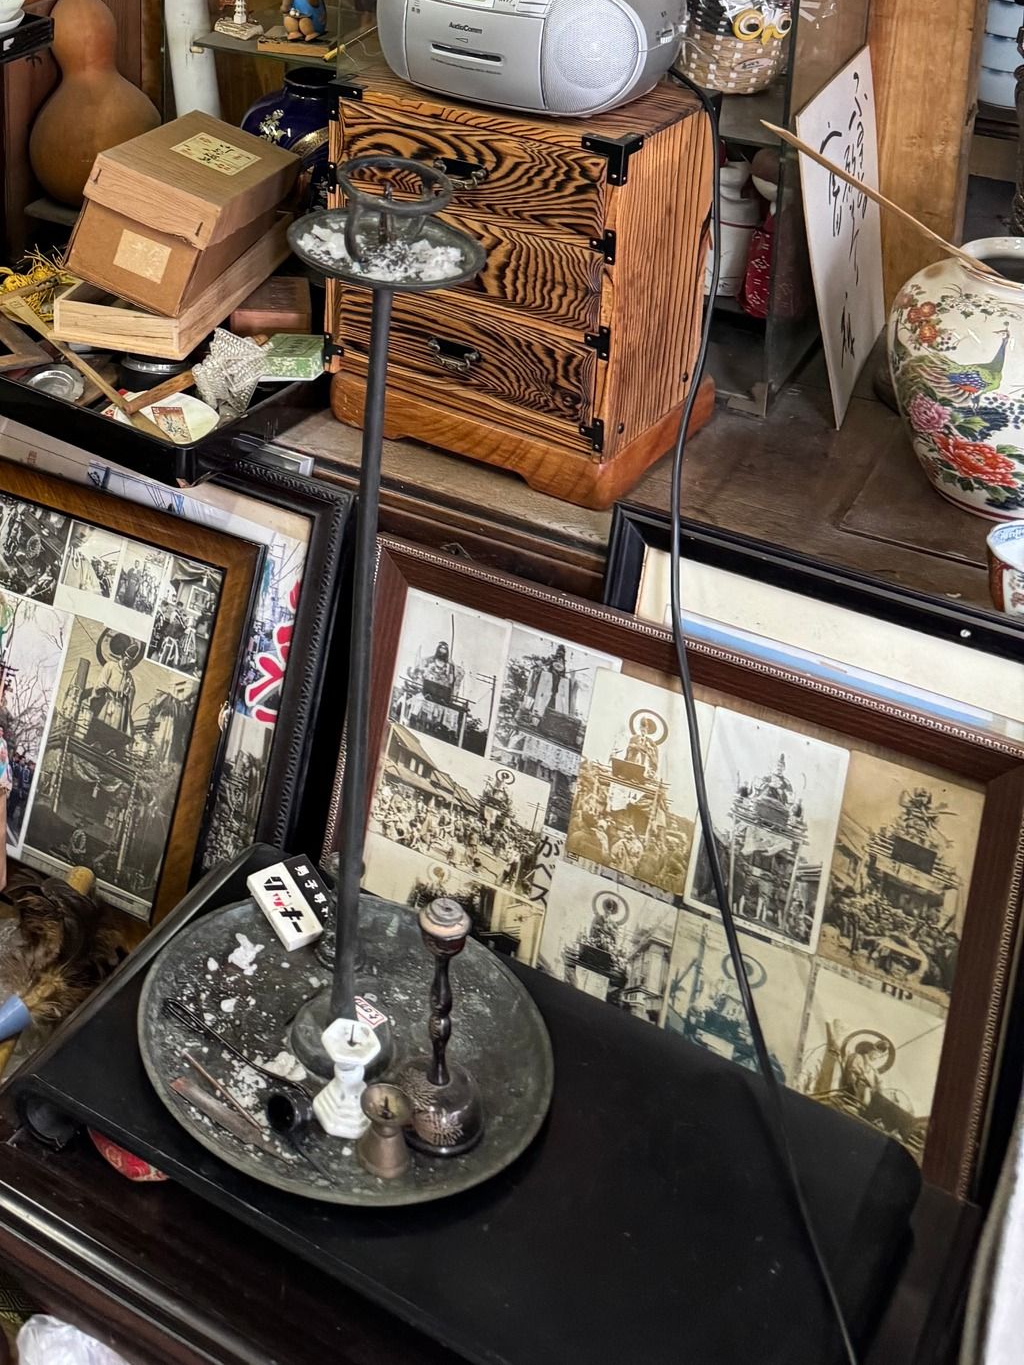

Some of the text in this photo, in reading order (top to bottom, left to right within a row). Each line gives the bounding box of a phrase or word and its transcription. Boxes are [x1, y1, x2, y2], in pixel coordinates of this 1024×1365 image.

[448, 20, 484, 35] AudioComm
[263, 876, 305, 933] グッキー
